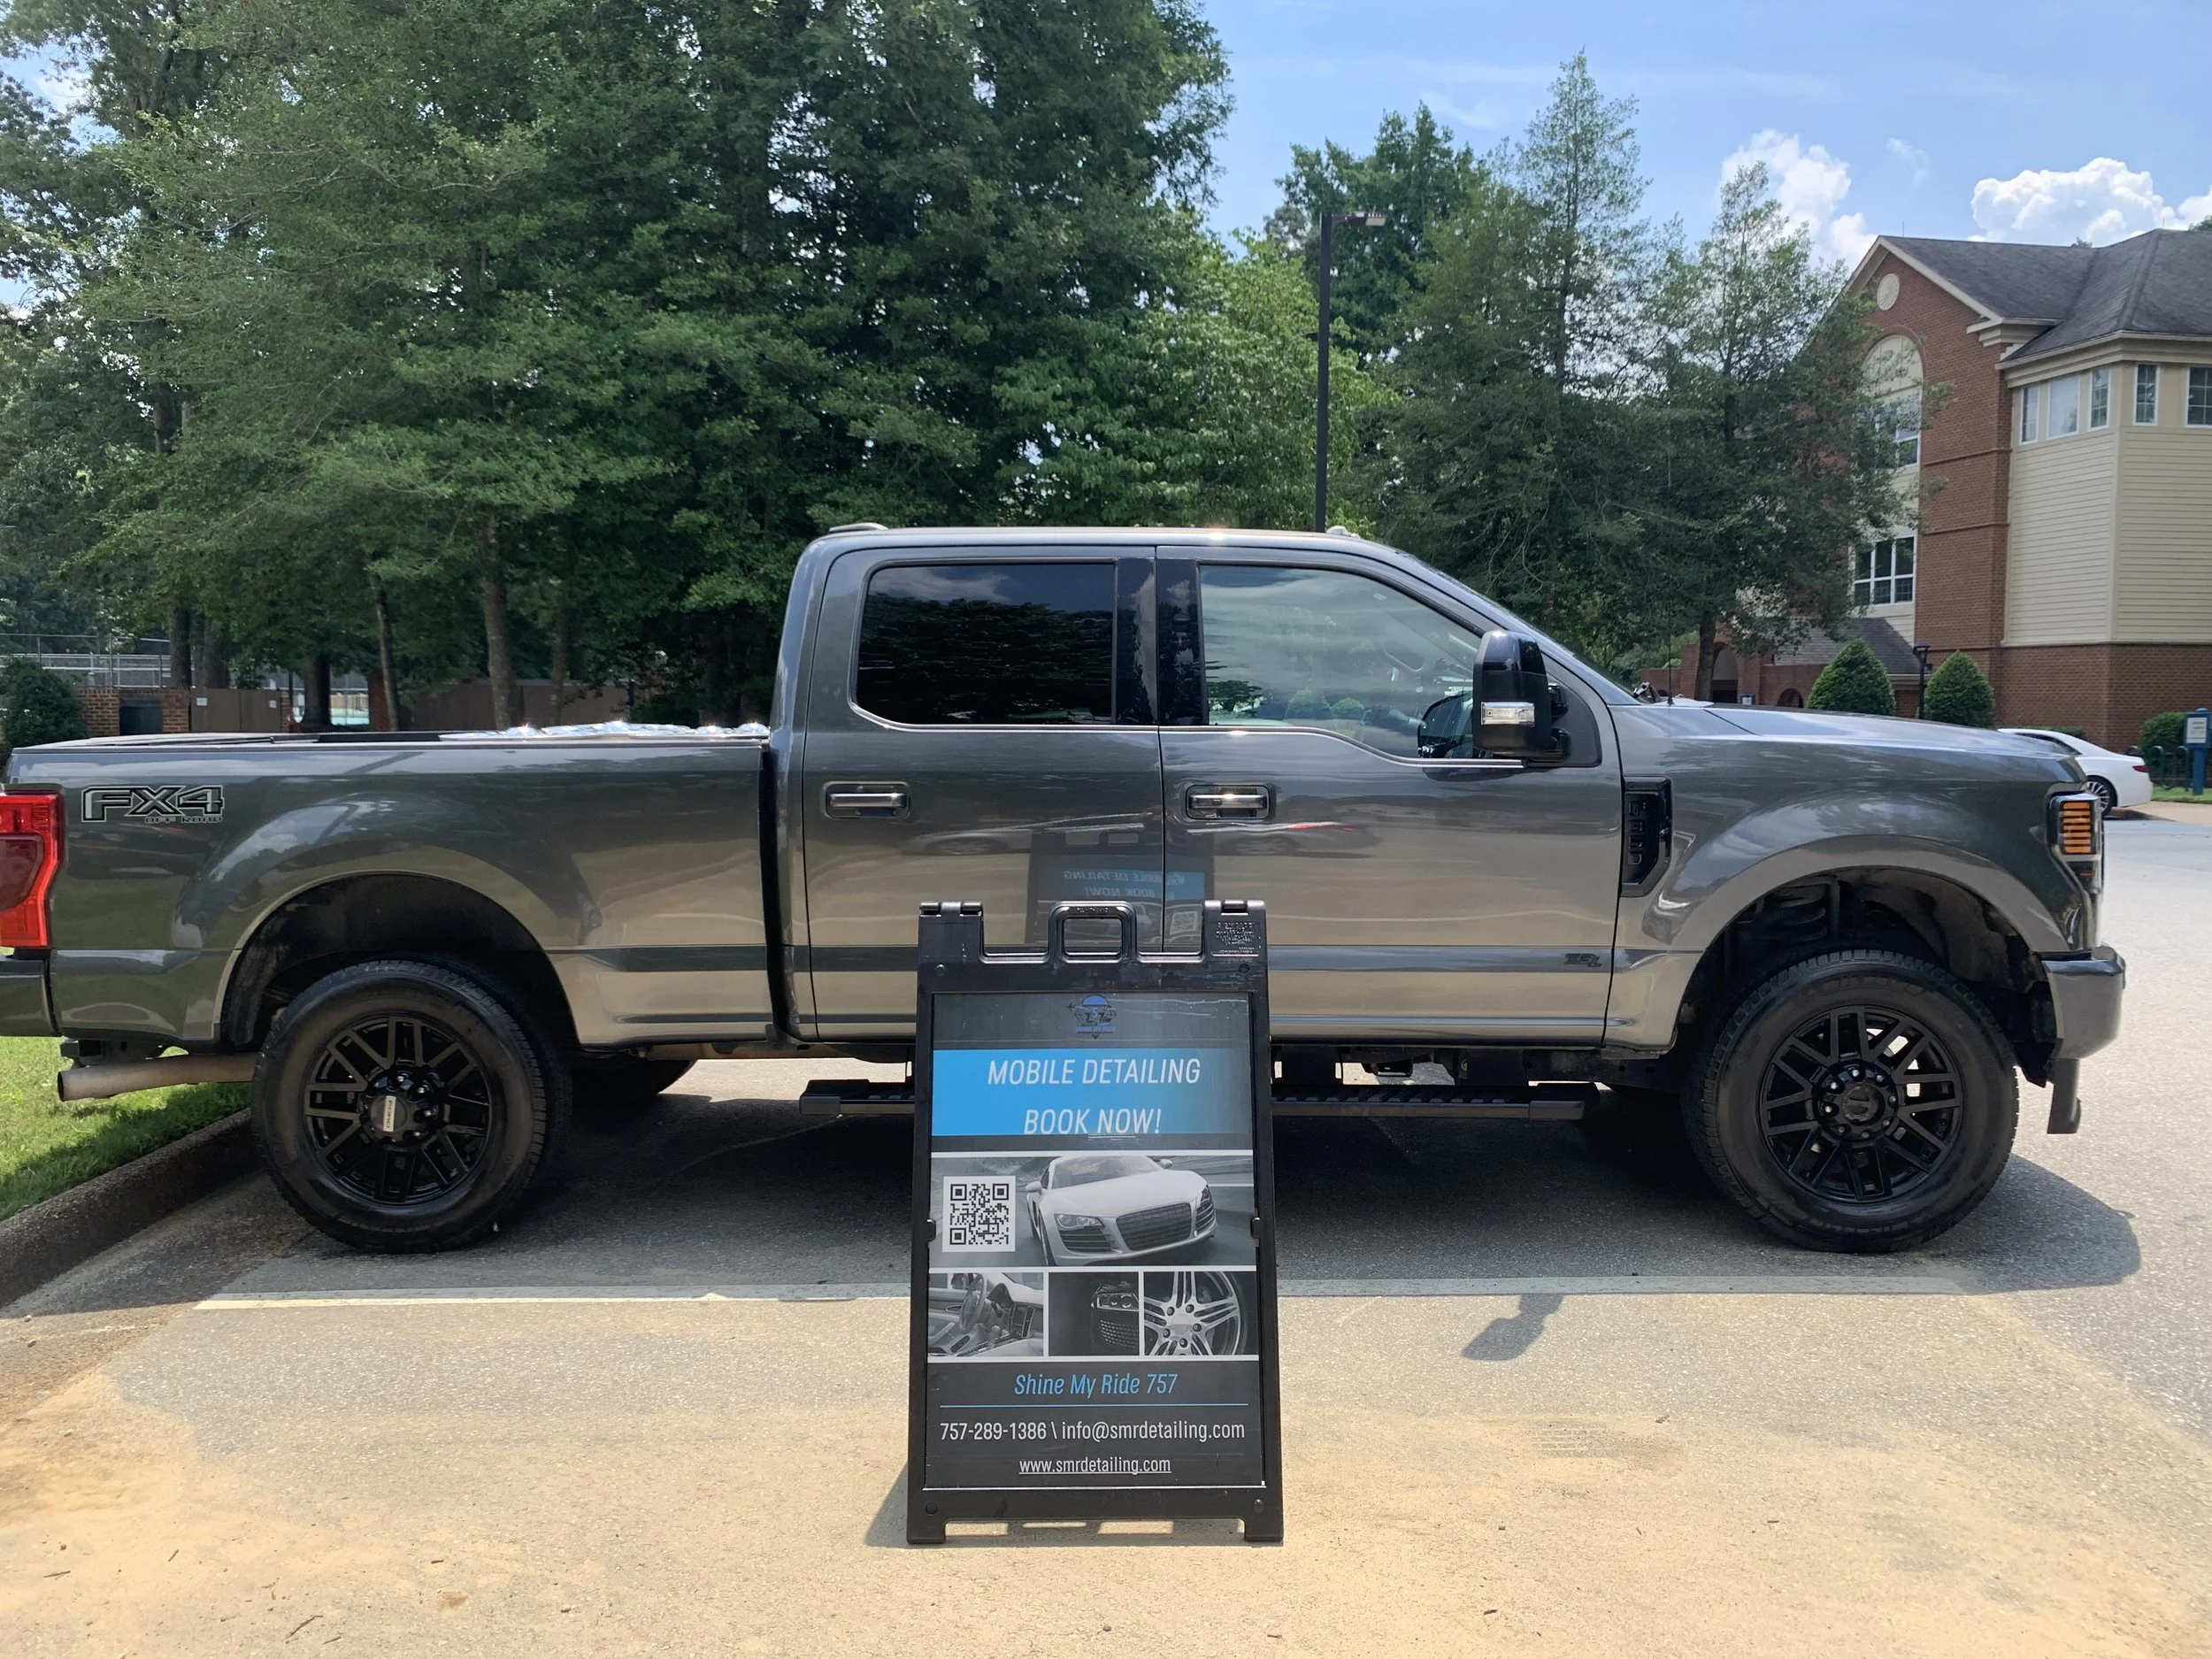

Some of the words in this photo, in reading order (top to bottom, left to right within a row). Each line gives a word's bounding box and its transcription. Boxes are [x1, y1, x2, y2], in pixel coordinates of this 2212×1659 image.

[81, 785, 224, 822] FX4
[987, 1060, 1076, 1085] MOBILE
[1082, 1058, 1202, 1084] DETAILING
[1024, 1109, 1091, 1134] BOOK
[1097, 1109, 1162, 1134] NOW!
[1014, 1373, 1065, 1394] Shine
[1070, 1374, 1097, 1399] My
[1101, 1373, 1141, 1394] Ride
[1147, 1373, 1179, 1394] 757
[940, 1422, 1047, 1440] 757-289-1386
[1062, 1420, 1246, 1443] info@smrdetailing.com
[1019, 1456, 1171, 1476] www.smrdetailing.com
